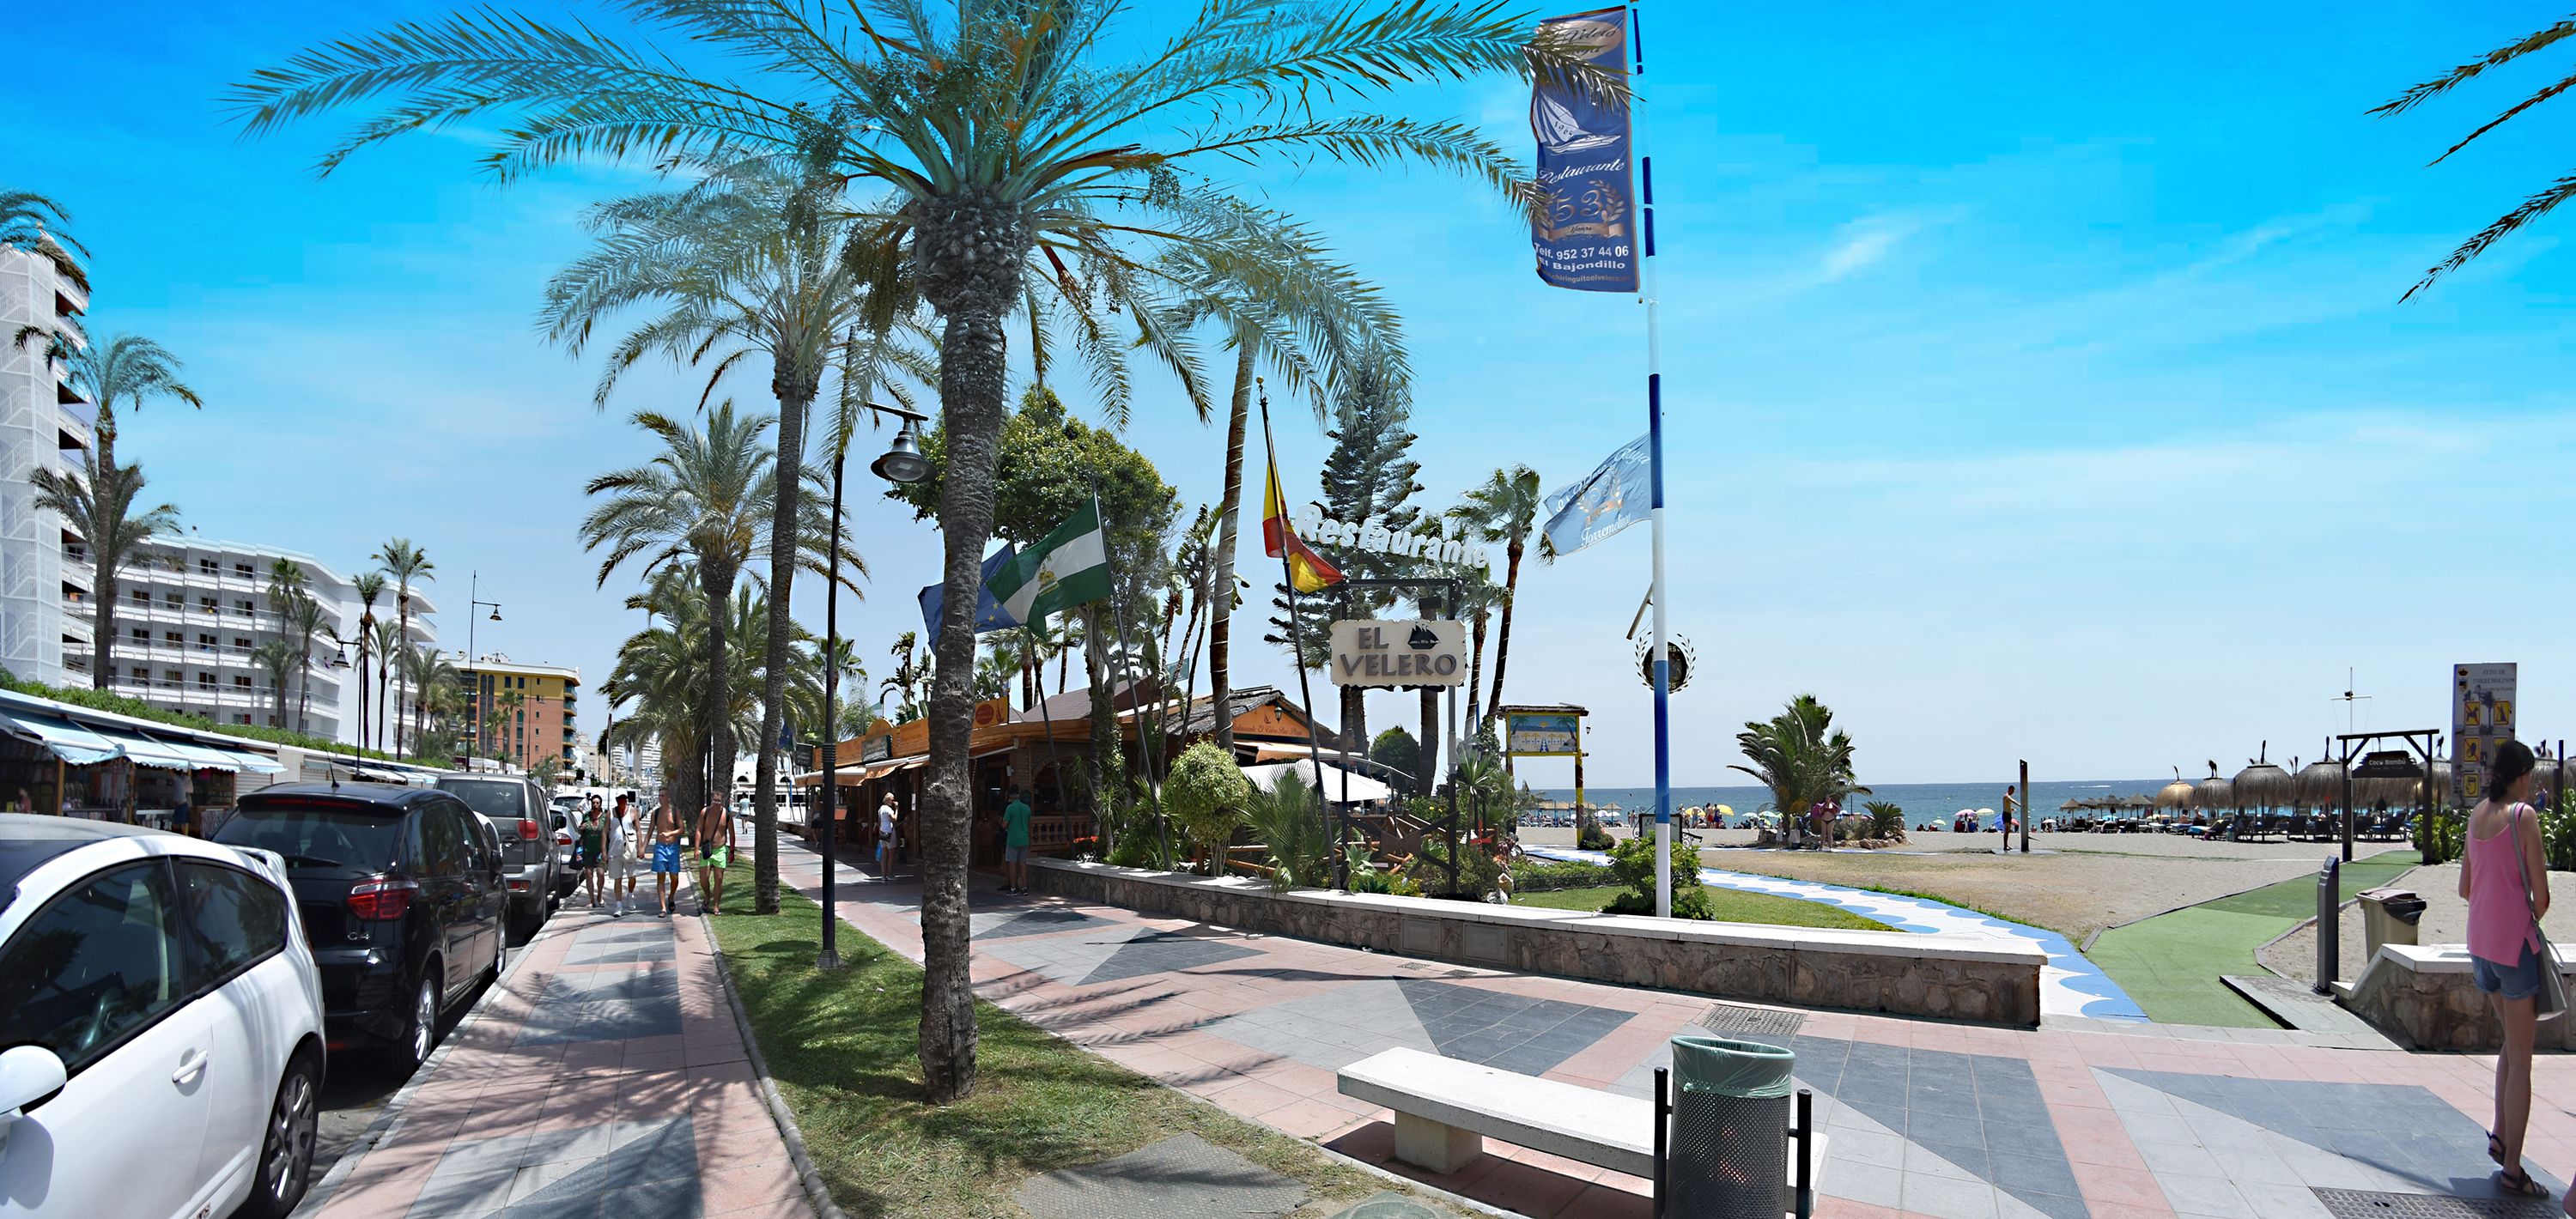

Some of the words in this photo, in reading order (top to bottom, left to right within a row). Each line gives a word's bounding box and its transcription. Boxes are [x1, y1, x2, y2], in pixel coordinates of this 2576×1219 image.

[1539, 158, 1625, 185] Restaurante
[1534, 242, 1553, 259] Telf.
[1556, 248, 1577, 260] 952
[1581, 246, 1595, 258] 37
[1598, 246, 1612, 257] 44
[1614, 245, 1629, 258] 06
[1552, 259, 1626, 272] Bajondillo
[1293, 503, 1492, 569] Restaurante
[1357, 626, 1389, 651] EL
[1340, 652, 1458, 677] VELERO
